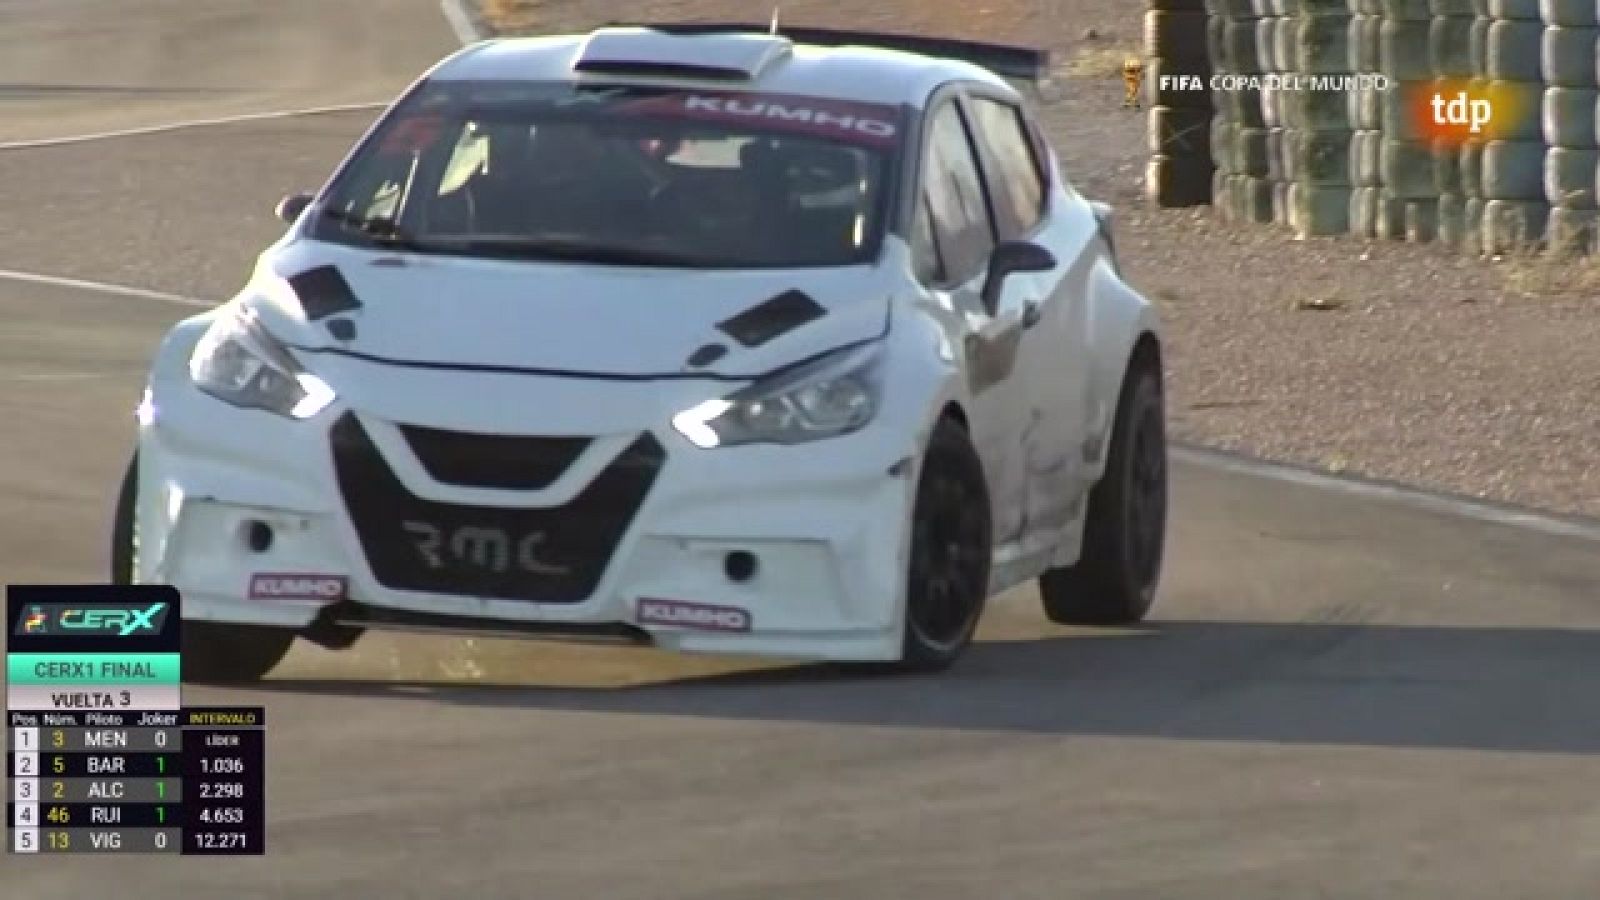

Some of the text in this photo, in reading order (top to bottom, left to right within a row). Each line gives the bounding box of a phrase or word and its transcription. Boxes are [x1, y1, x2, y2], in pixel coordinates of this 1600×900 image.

[684, 95, 895, 137] KUMHO
[252, 579, 343, 597] KUMHO
[641, 604, 746, 627] KUMHO
